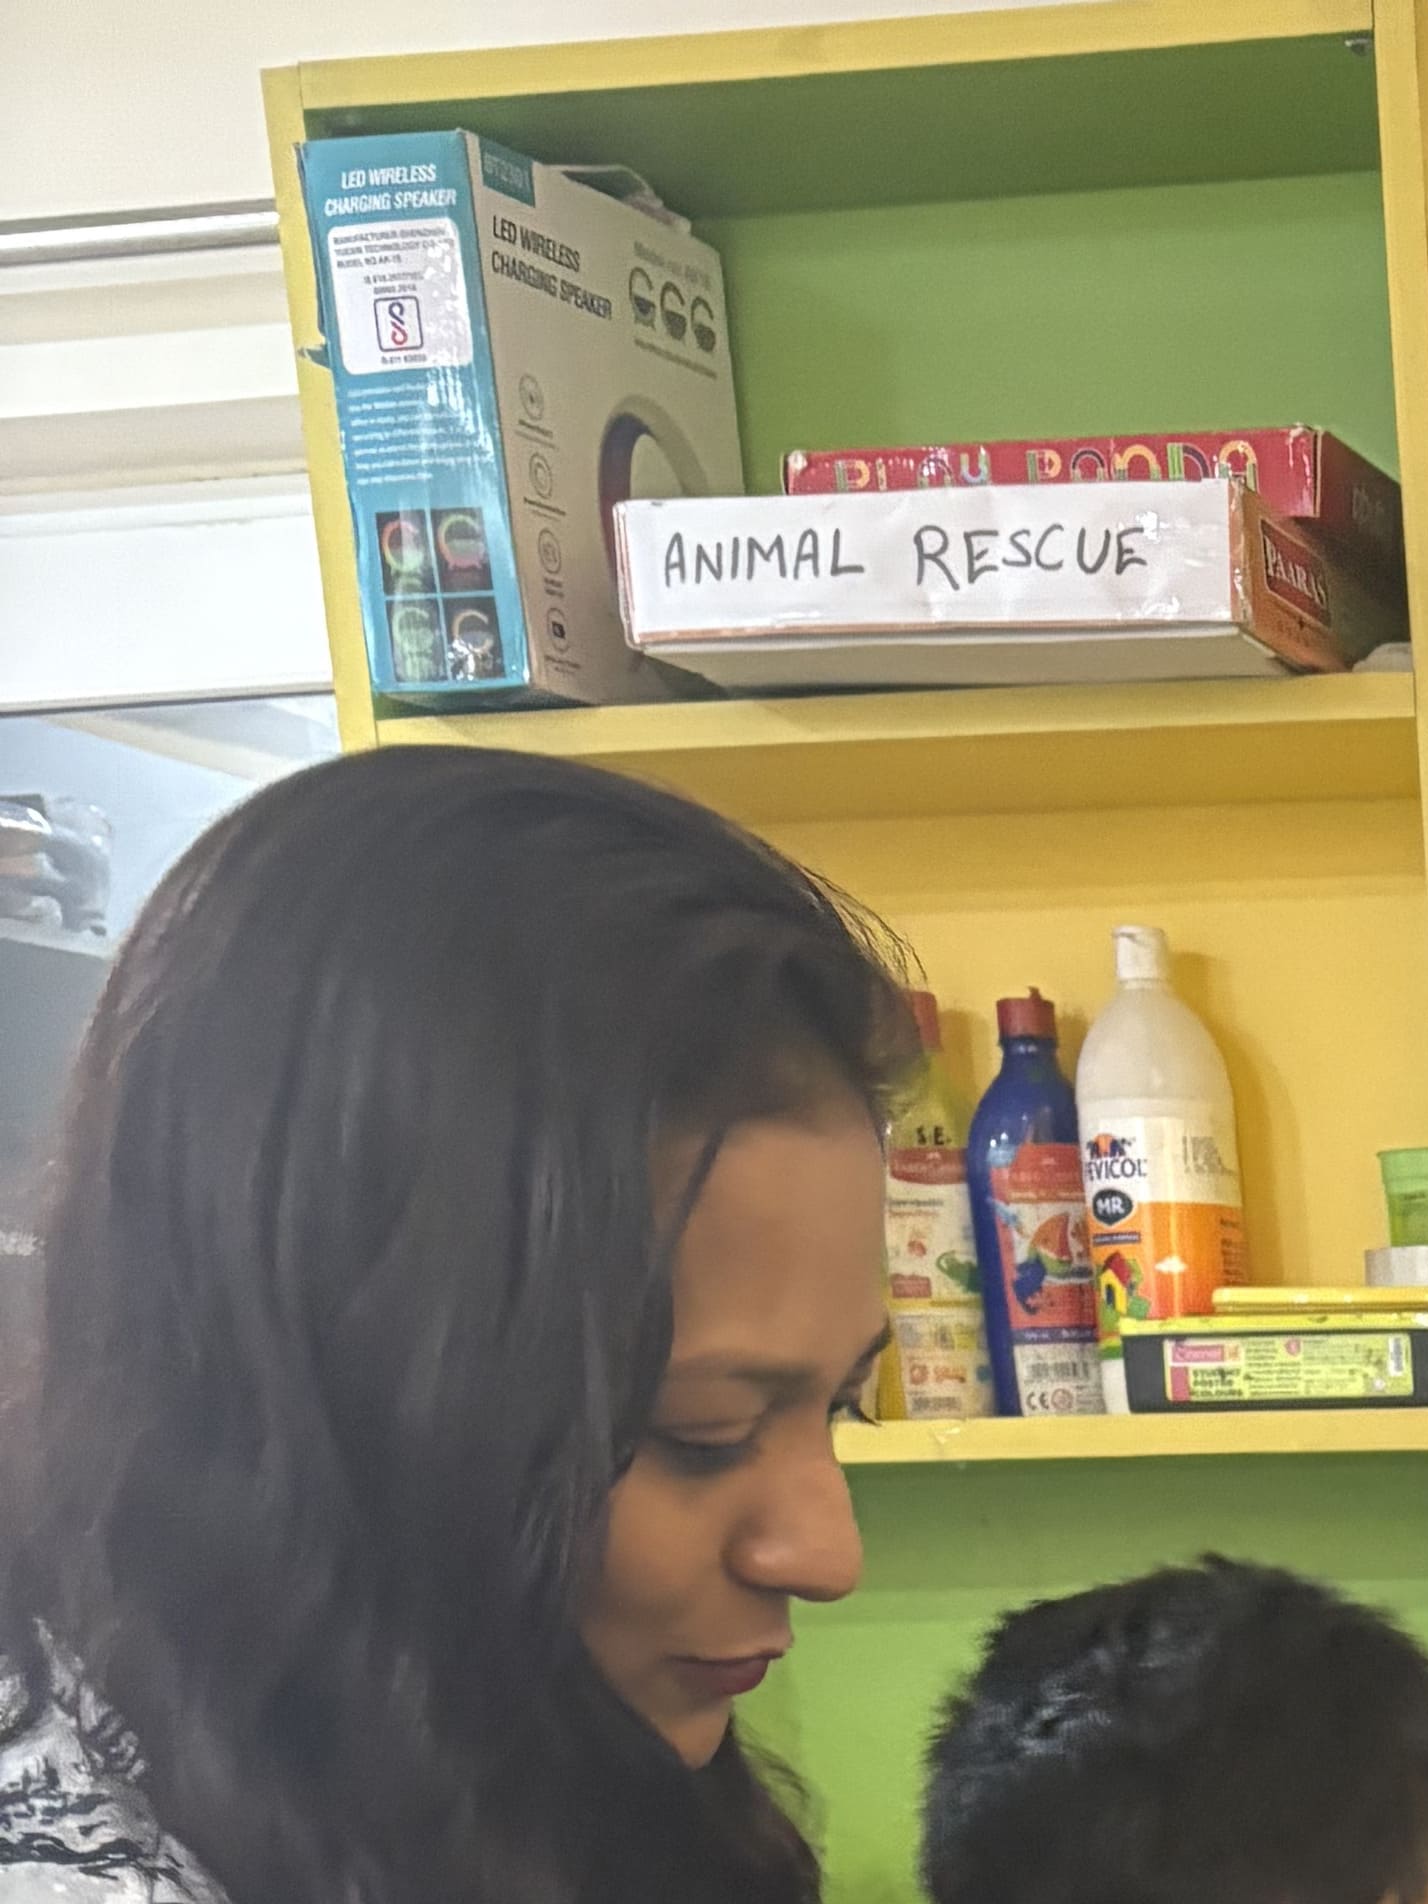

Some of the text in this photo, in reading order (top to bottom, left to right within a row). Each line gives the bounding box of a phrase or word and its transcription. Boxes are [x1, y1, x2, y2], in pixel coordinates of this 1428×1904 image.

[341, 163, 437, 190] LED WIRELESS
[324, 188, 457, 217] CHARGING SPEAKER
[492, 214, 581, 273] LED WIRELESS
[491, 250, 613, 321] CHARGING SPEAKER
[664, 523, 1149, 592] ANIMAL RESCUE
[1095, 1195, 1126, 1215] MR
